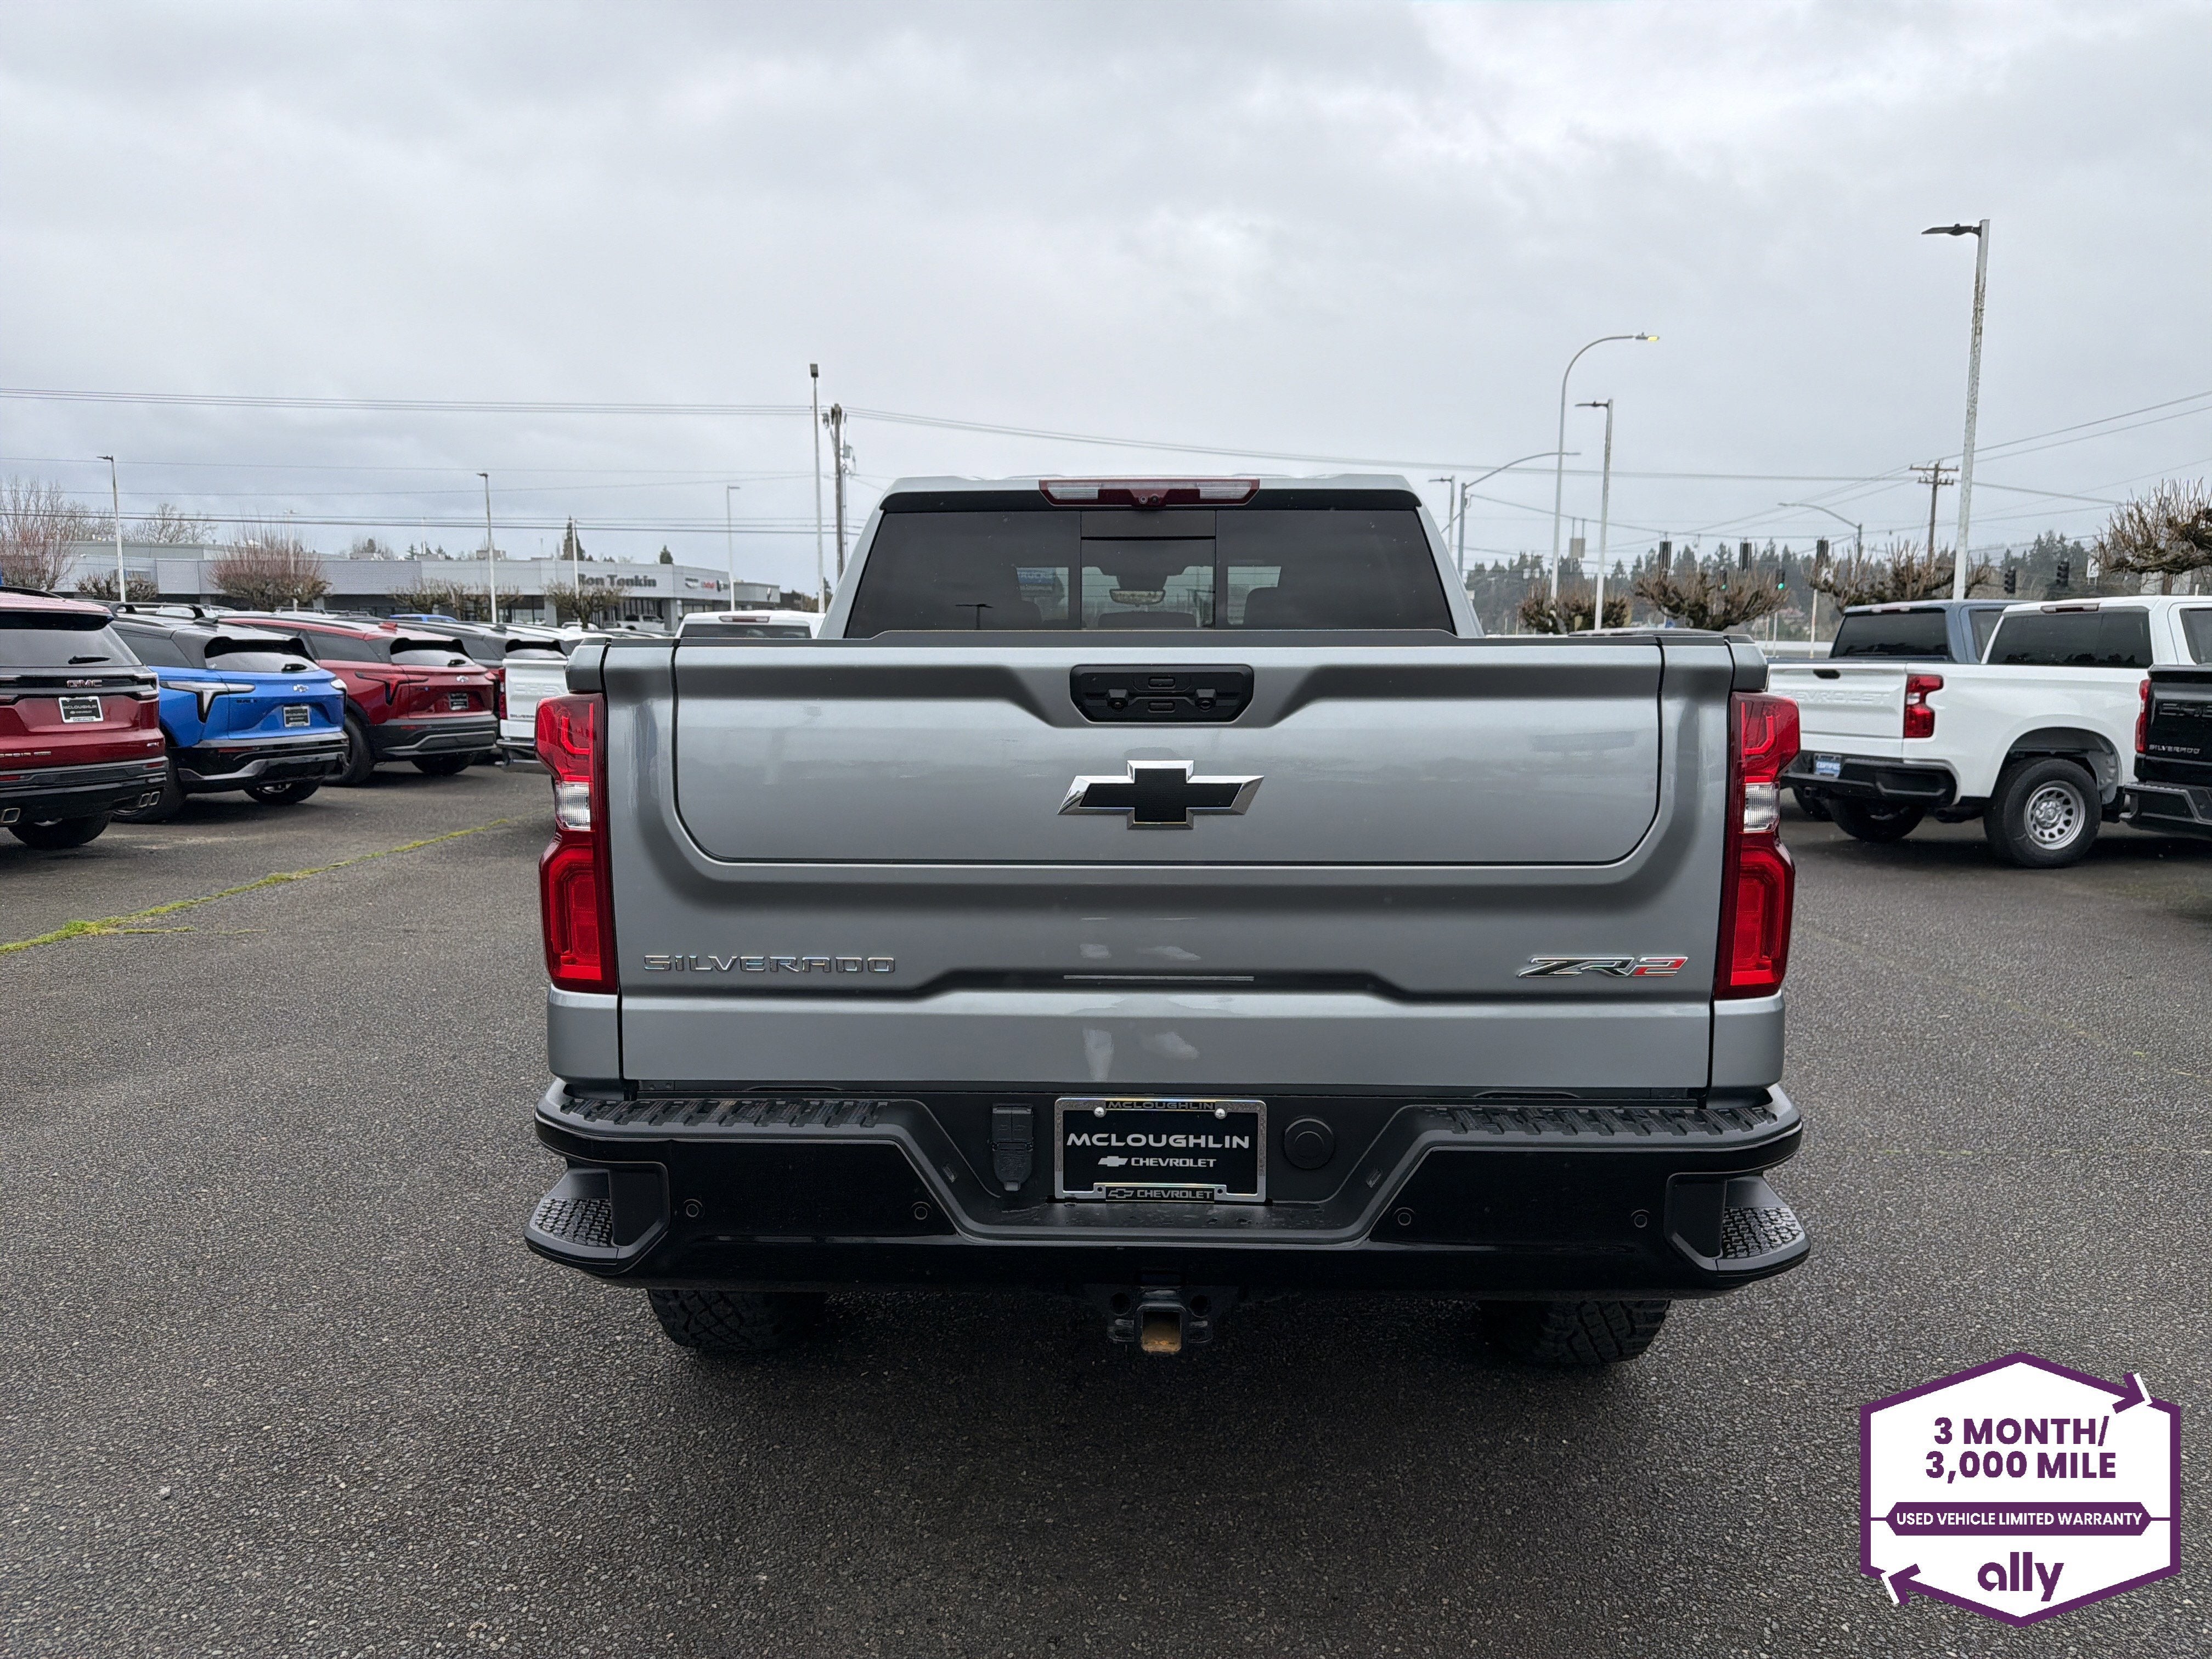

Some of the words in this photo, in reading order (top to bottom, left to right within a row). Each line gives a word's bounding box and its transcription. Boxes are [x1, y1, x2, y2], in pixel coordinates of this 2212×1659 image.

[578, 573, 605, 585] Ron
[606, 574, 657, 586] Tonkin
[66, 679, 102, 687] GMC
[2149, 744, 2200, 754] SILVERADO
[644, 954, 896, 973] SILVERADO
[1516, 956, 1689, 978] ZR2
[1108, 1101, 1214, 1110] MCLOUGHLIN
[1066, 1133, 1249, 1149] MCLOUGHLIN
[1131, 1157, 1217, 1167] CHEVROLET
[1137, 1189, 1213, 1199] CHEVROLET
